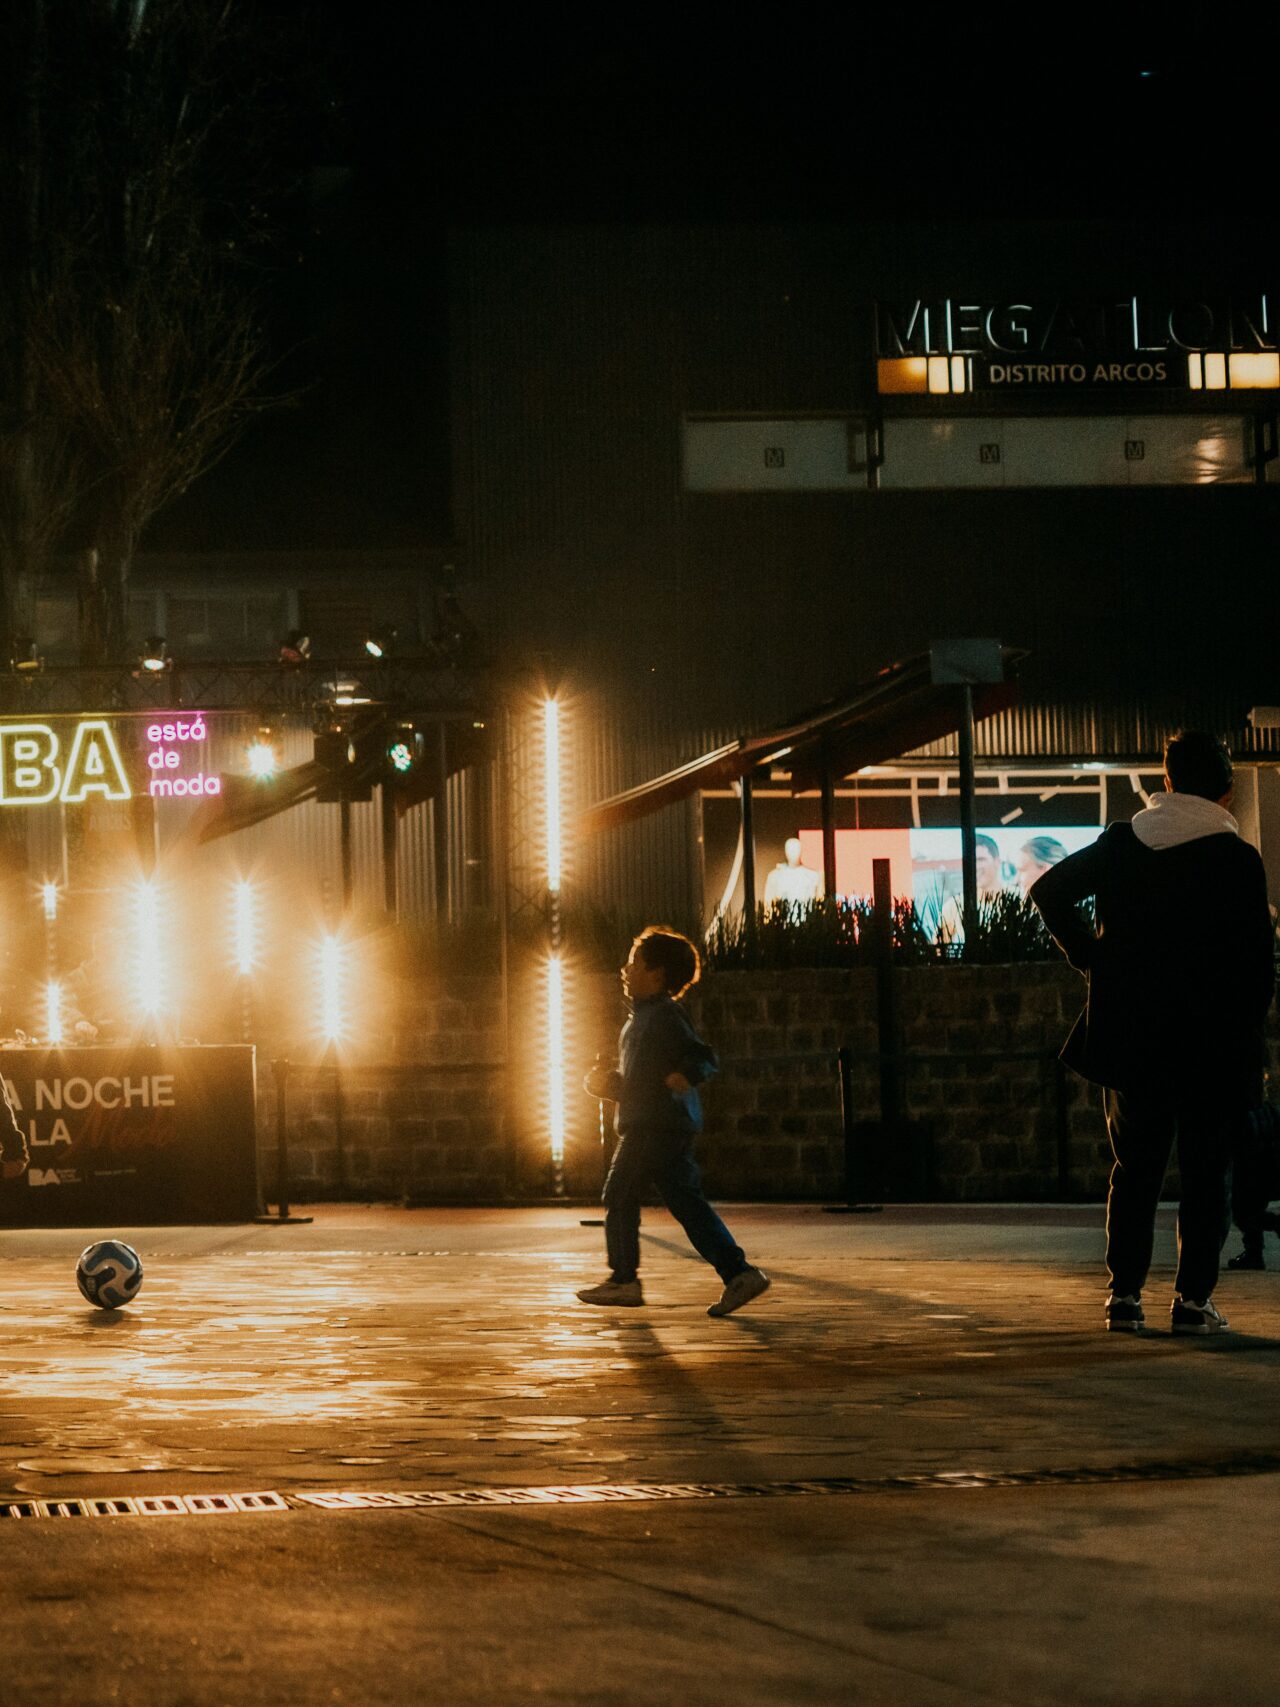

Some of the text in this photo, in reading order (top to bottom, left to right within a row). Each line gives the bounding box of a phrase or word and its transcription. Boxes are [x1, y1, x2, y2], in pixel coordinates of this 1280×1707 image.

[989, 362, 1167, 384] DISTRITO ARCOS
[147, 717, 206, 741] está
[148, 747, 180, 769] de
[150, 773, 220, 796] moda
[35, 1075, 176, 1111] NOCHE
[29, 1118, 73, 1147] LA
